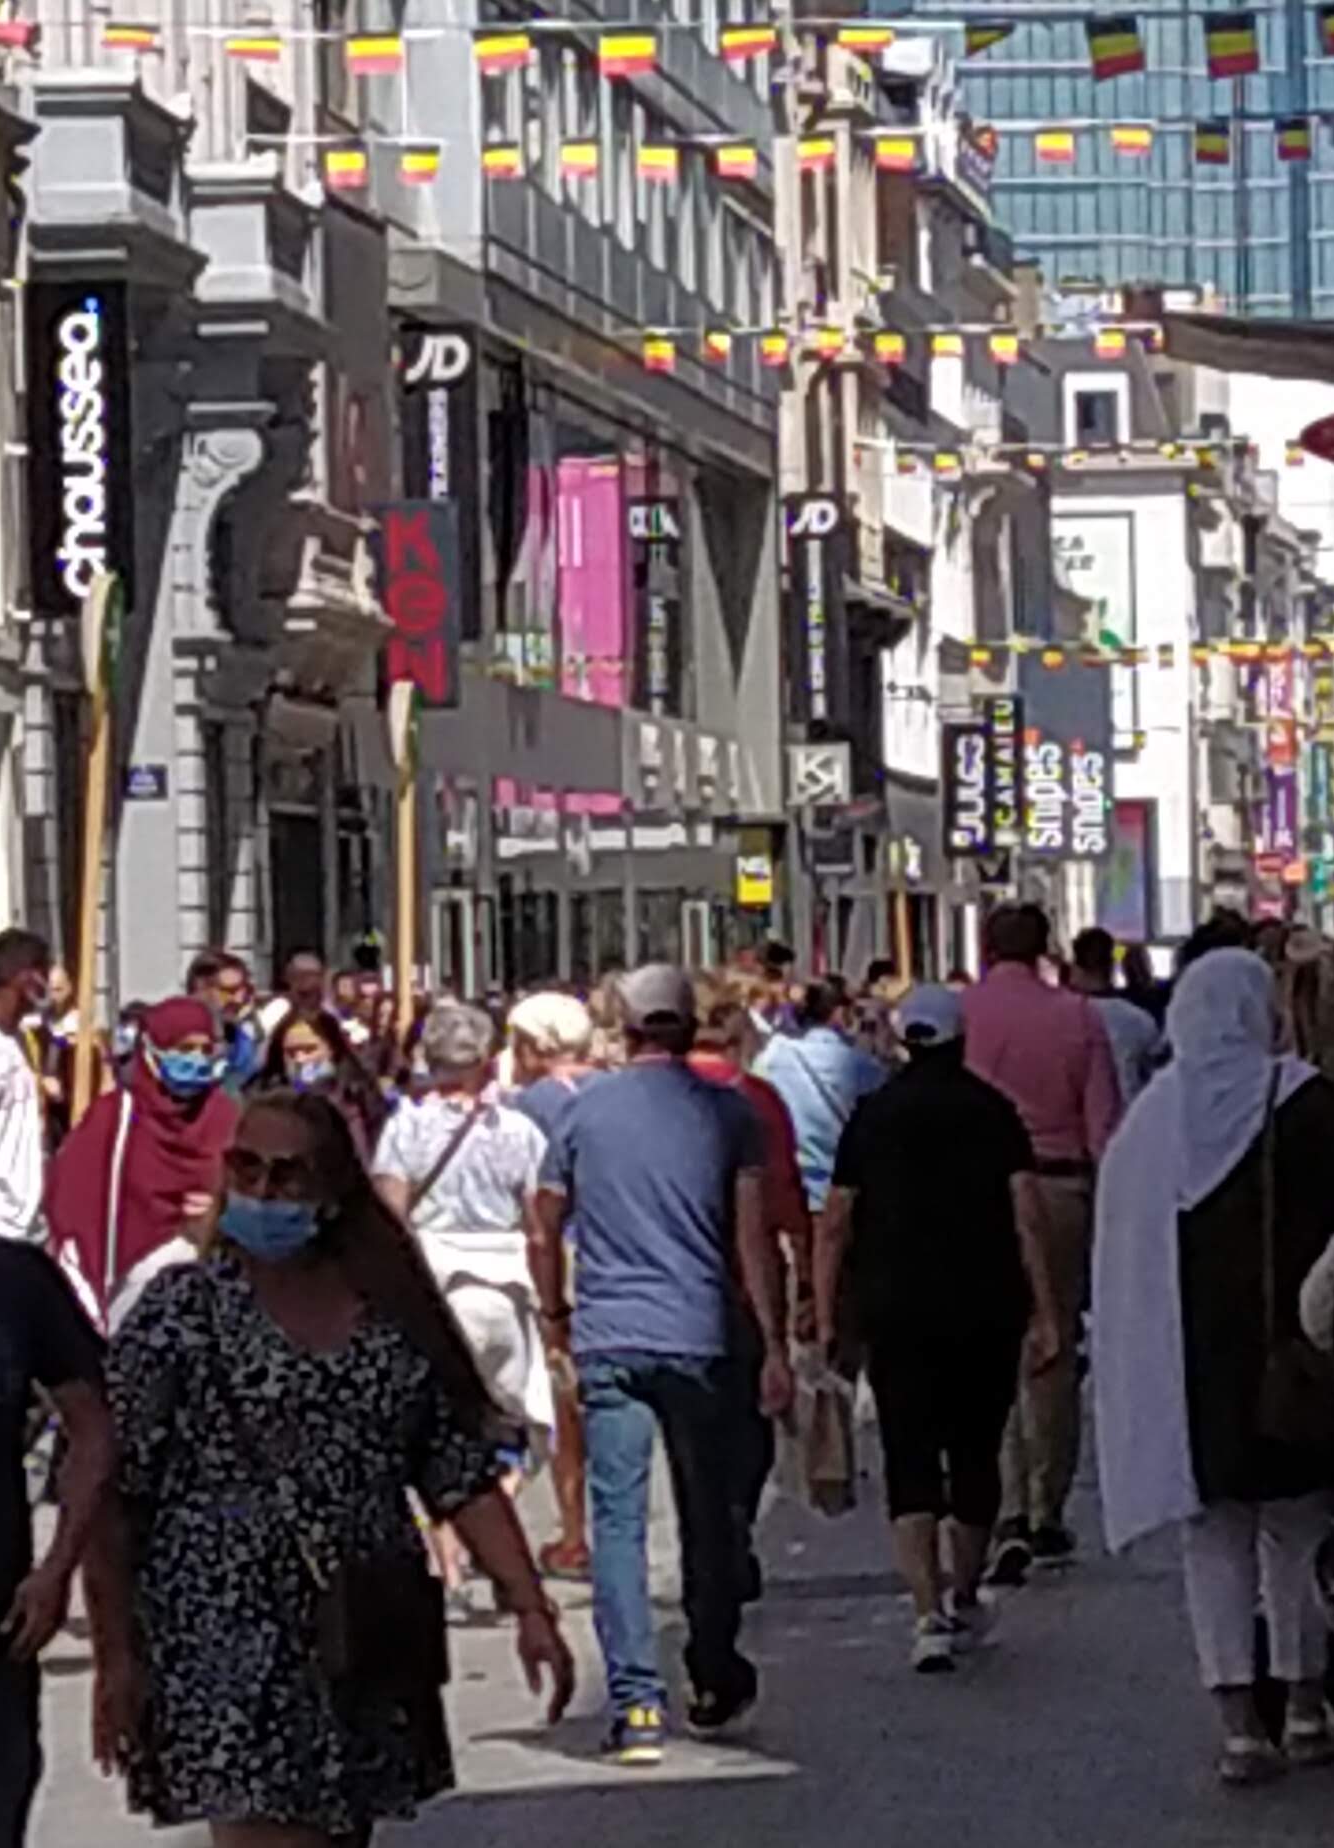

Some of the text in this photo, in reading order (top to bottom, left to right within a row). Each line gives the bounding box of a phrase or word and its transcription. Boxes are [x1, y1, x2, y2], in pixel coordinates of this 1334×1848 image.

[406, 334, 469, 382] JD
[790, 502, 838, 535] JD
[1026, 741, 1067, 848] snipes
